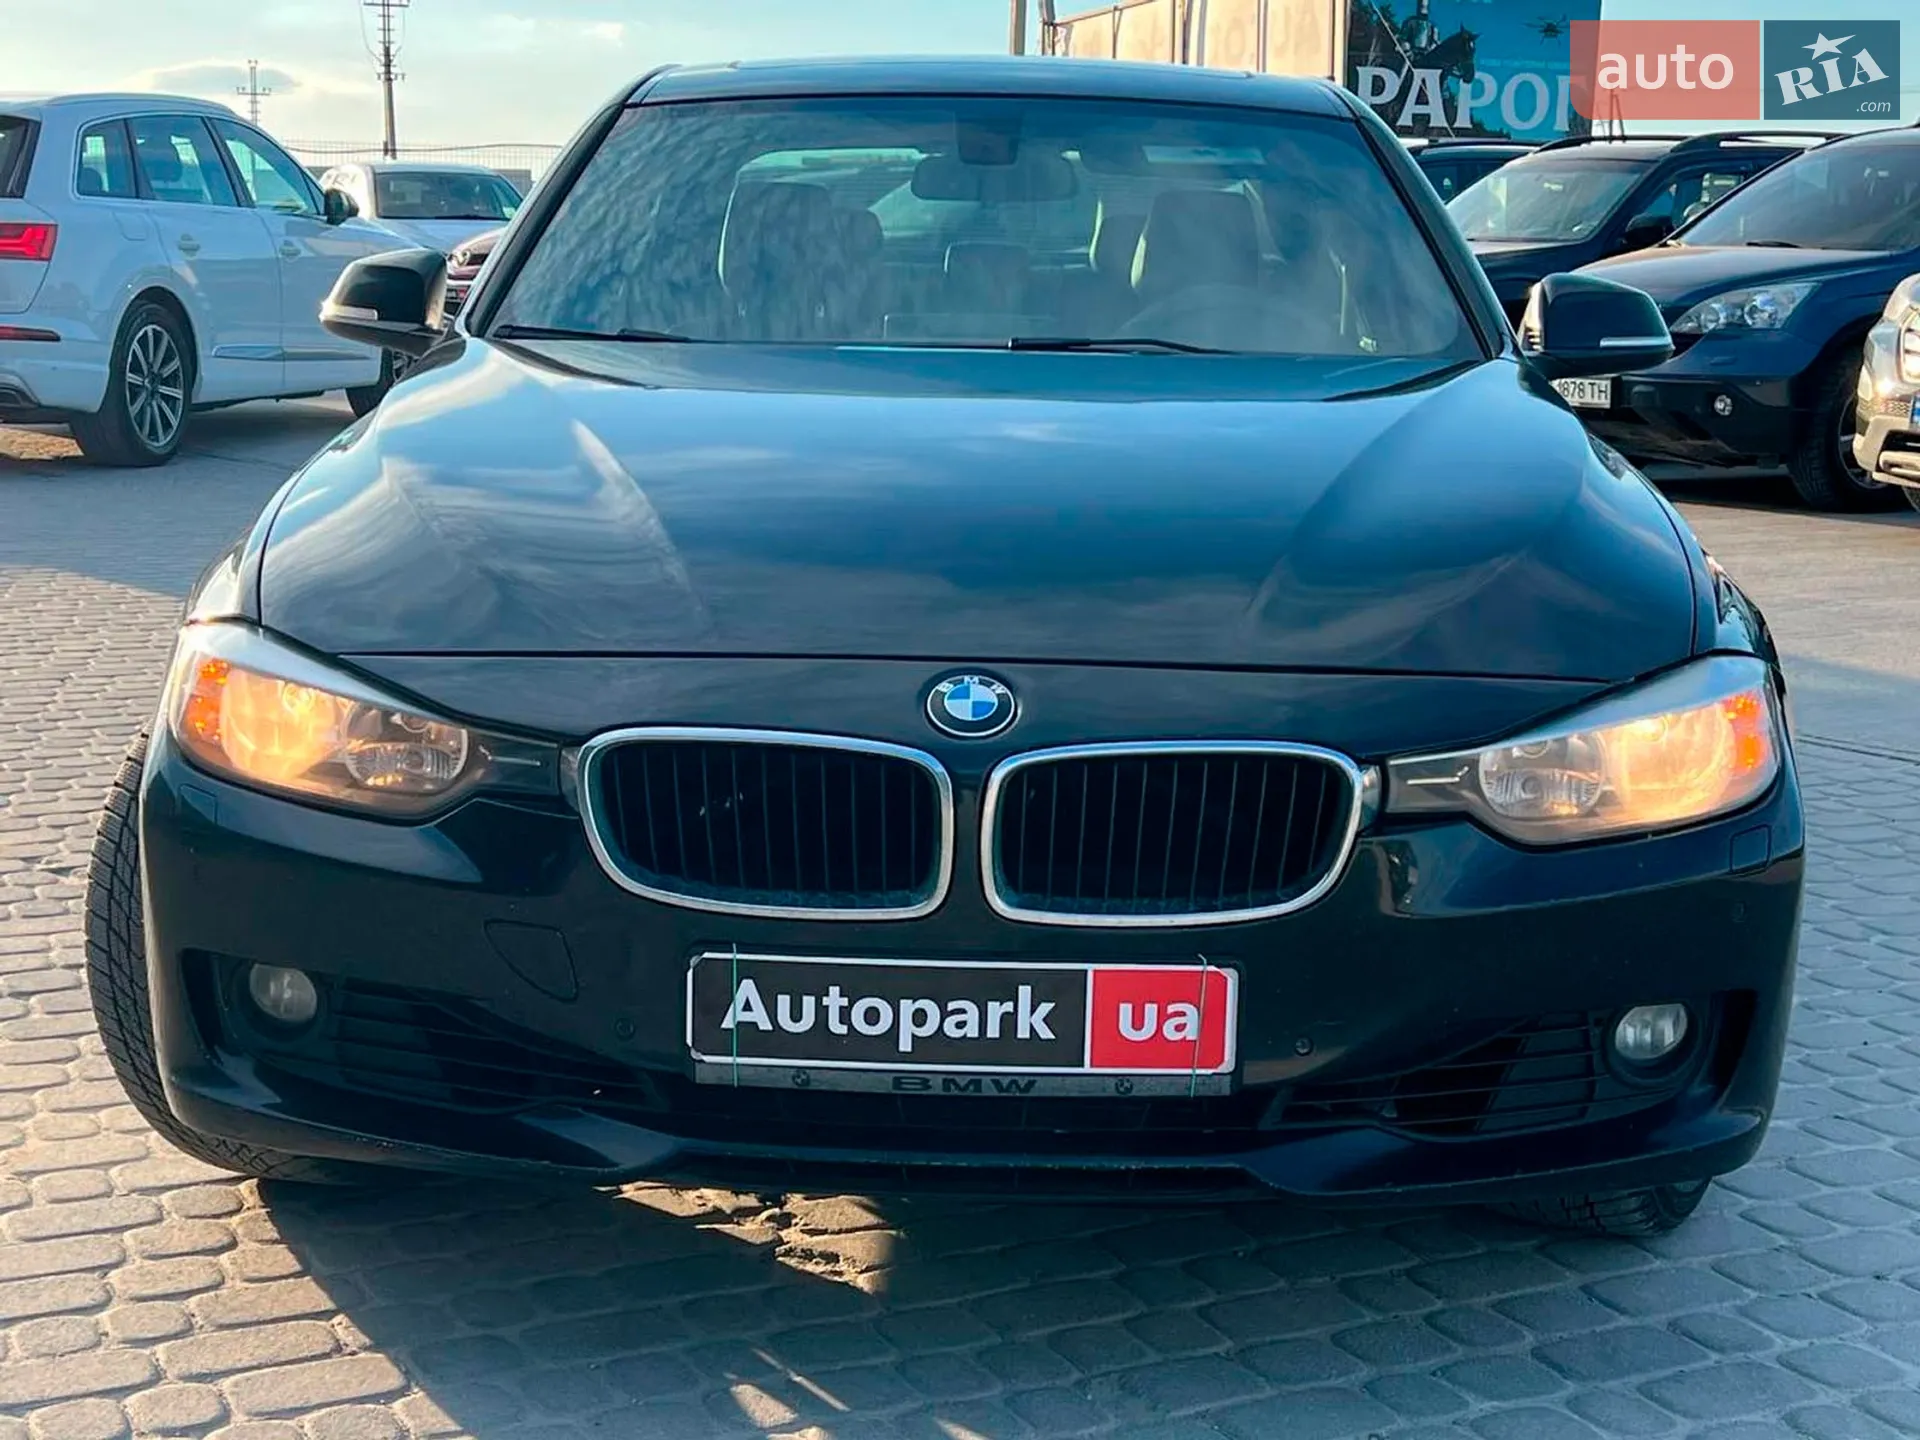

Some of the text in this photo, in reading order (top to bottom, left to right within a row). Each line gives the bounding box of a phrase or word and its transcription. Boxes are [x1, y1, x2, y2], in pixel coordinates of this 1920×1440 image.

[1588, 382, 1608, 400] TH
[936, 675, 1006, 693] BMW
[720, 978, 1201, 1052] Autopark ua
[892, 1076, 1037, 1095] BMW
